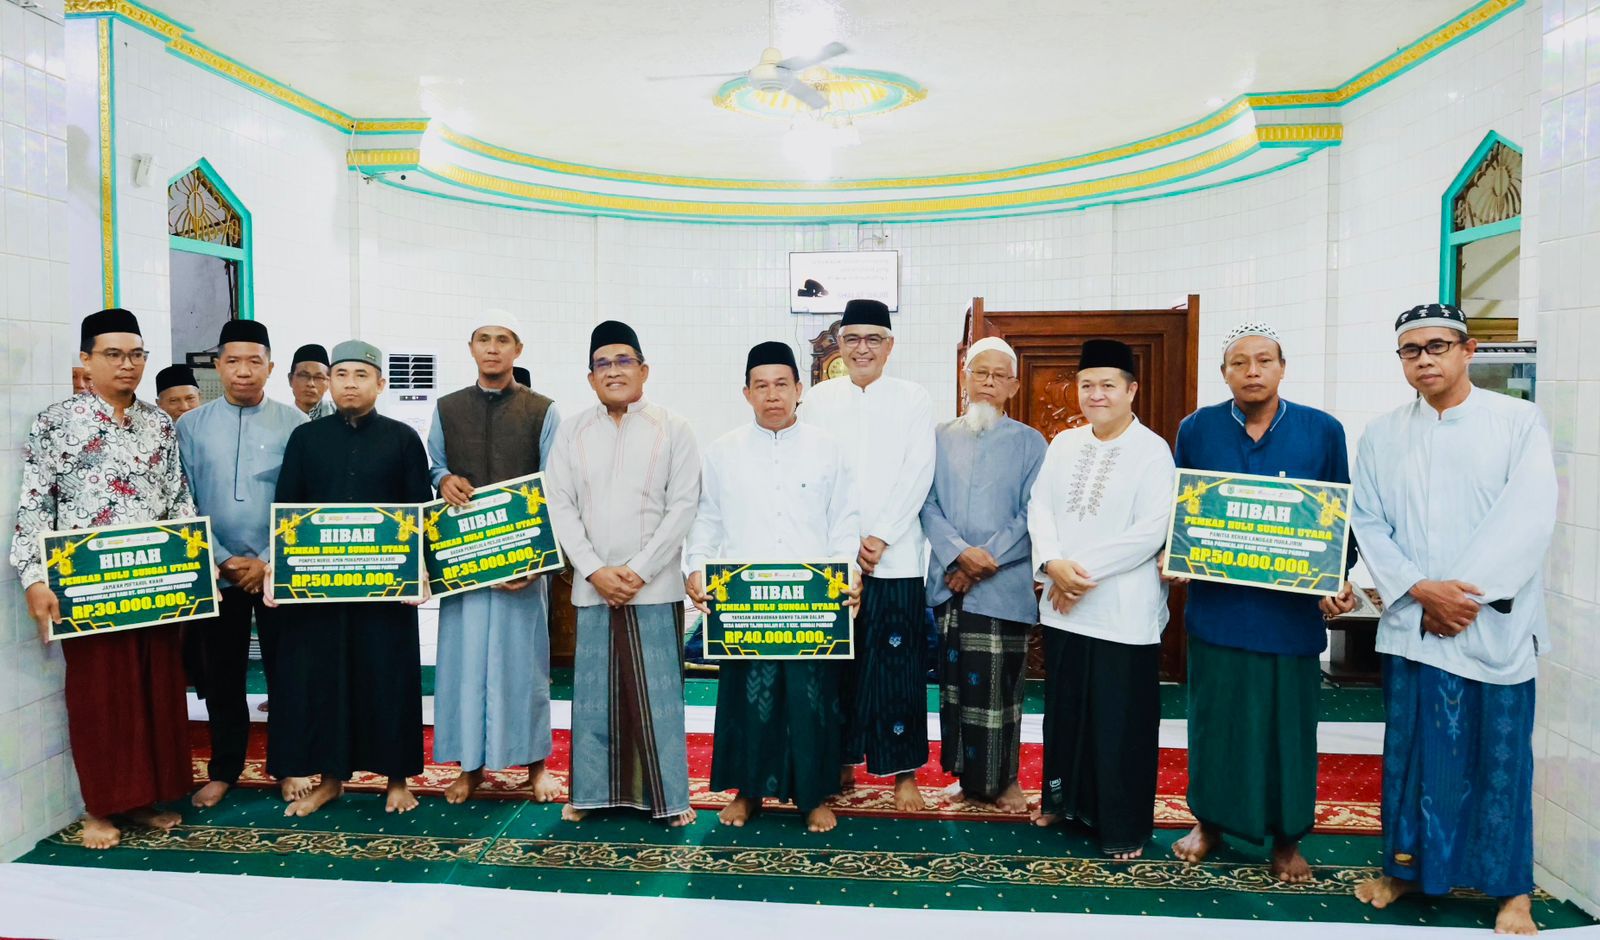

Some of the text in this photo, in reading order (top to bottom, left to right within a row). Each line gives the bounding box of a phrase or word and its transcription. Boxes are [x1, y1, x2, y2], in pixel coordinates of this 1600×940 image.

[458, 508, 508, 533] HIBAH
[1226, 501, 1291, 523] HIBAH
[320, 528, 375, 542] HIBAH
[430, 516, 543, 551] PEMKAB HULU SUNGAI UTARA
[1184, 516, 1332, 540] PEMKAB HULU SUNGAI UTARA
[99, 548, 161, 569] HIBAH
[284, 545, 410, 555] PEMKAB HULU SUNGAI UTARA
[59, 561, 201, 587] PEMKAB HULU SUNGAI UTARA
[750, 586, 804, 600] HIBAH
[716, 603, 840, 611] PEMKAB HULU SUNGAI UTARA
